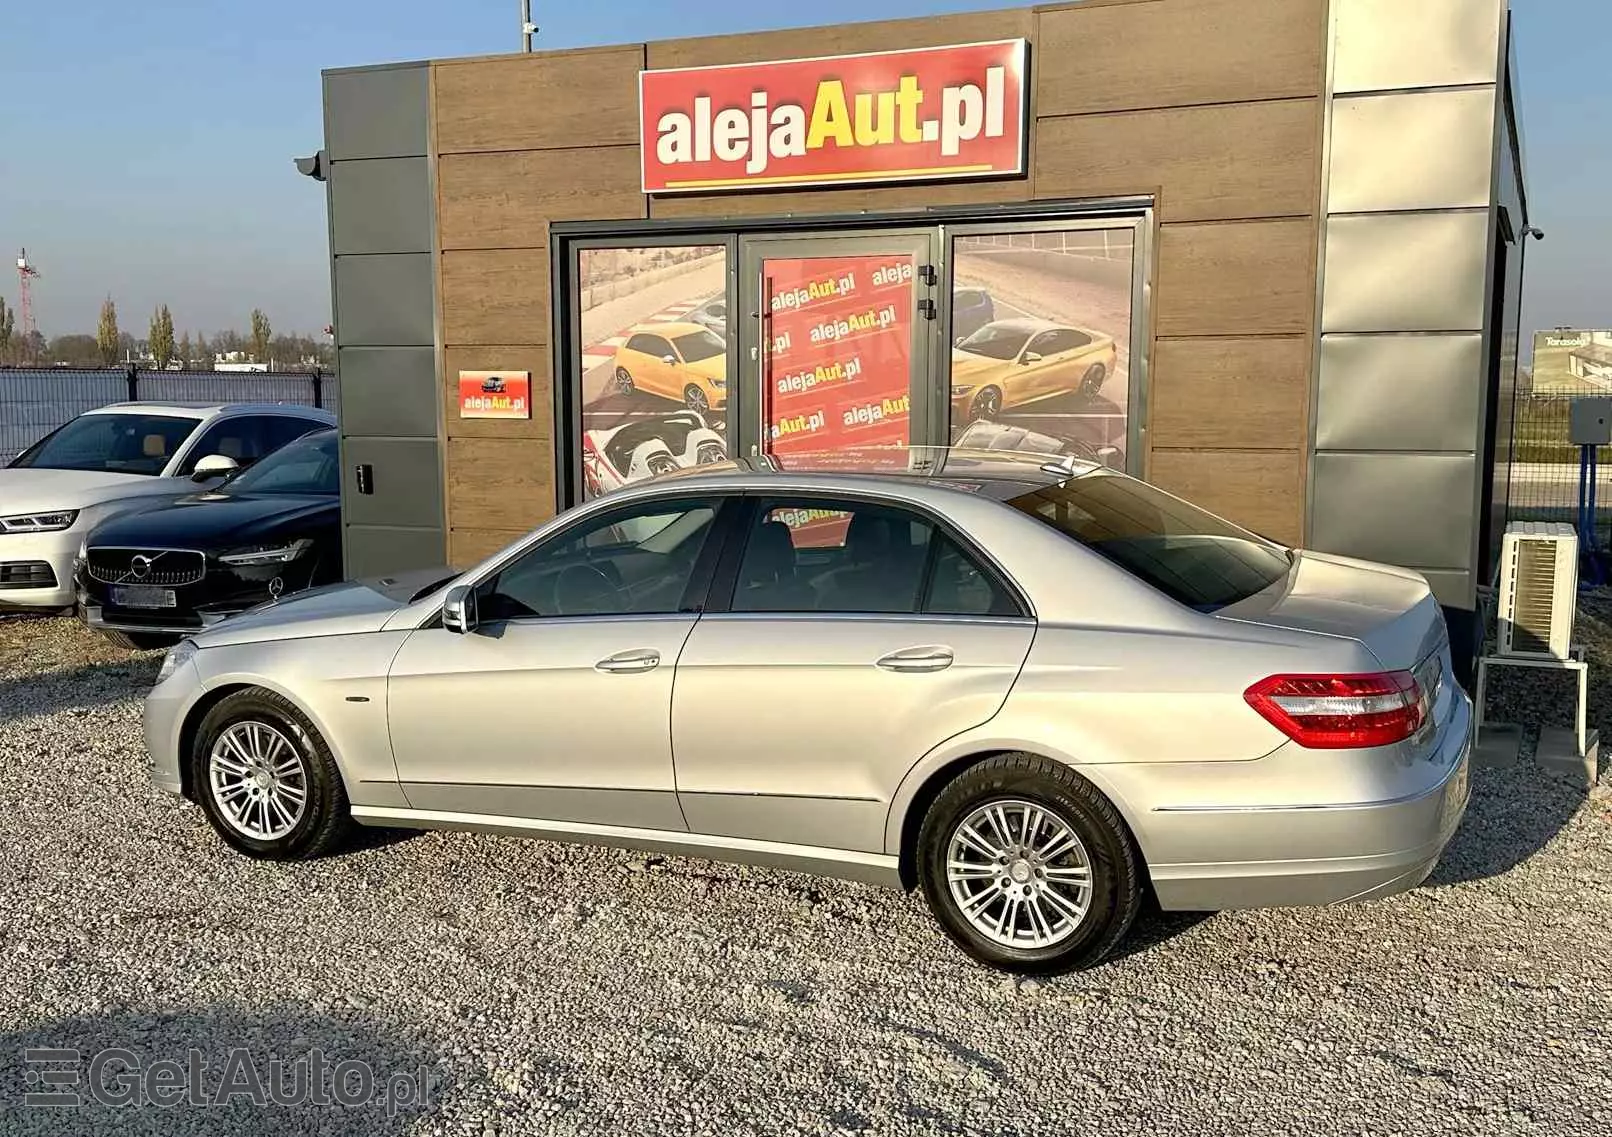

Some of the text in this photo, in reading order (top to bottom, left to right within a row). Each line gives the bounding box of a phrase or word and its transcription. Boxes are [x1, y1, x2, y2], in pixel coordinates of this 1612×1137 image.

[656, 66, 1005, 174] alejaAut.pl
[772, 272, 855, 311] alejaAut.pl
[810, 304, 896, 342] alejaAut.pl
[777, 357, 861, 393] alejaAut.pl
[464, 396, 525, 411] alejaAut.pl
